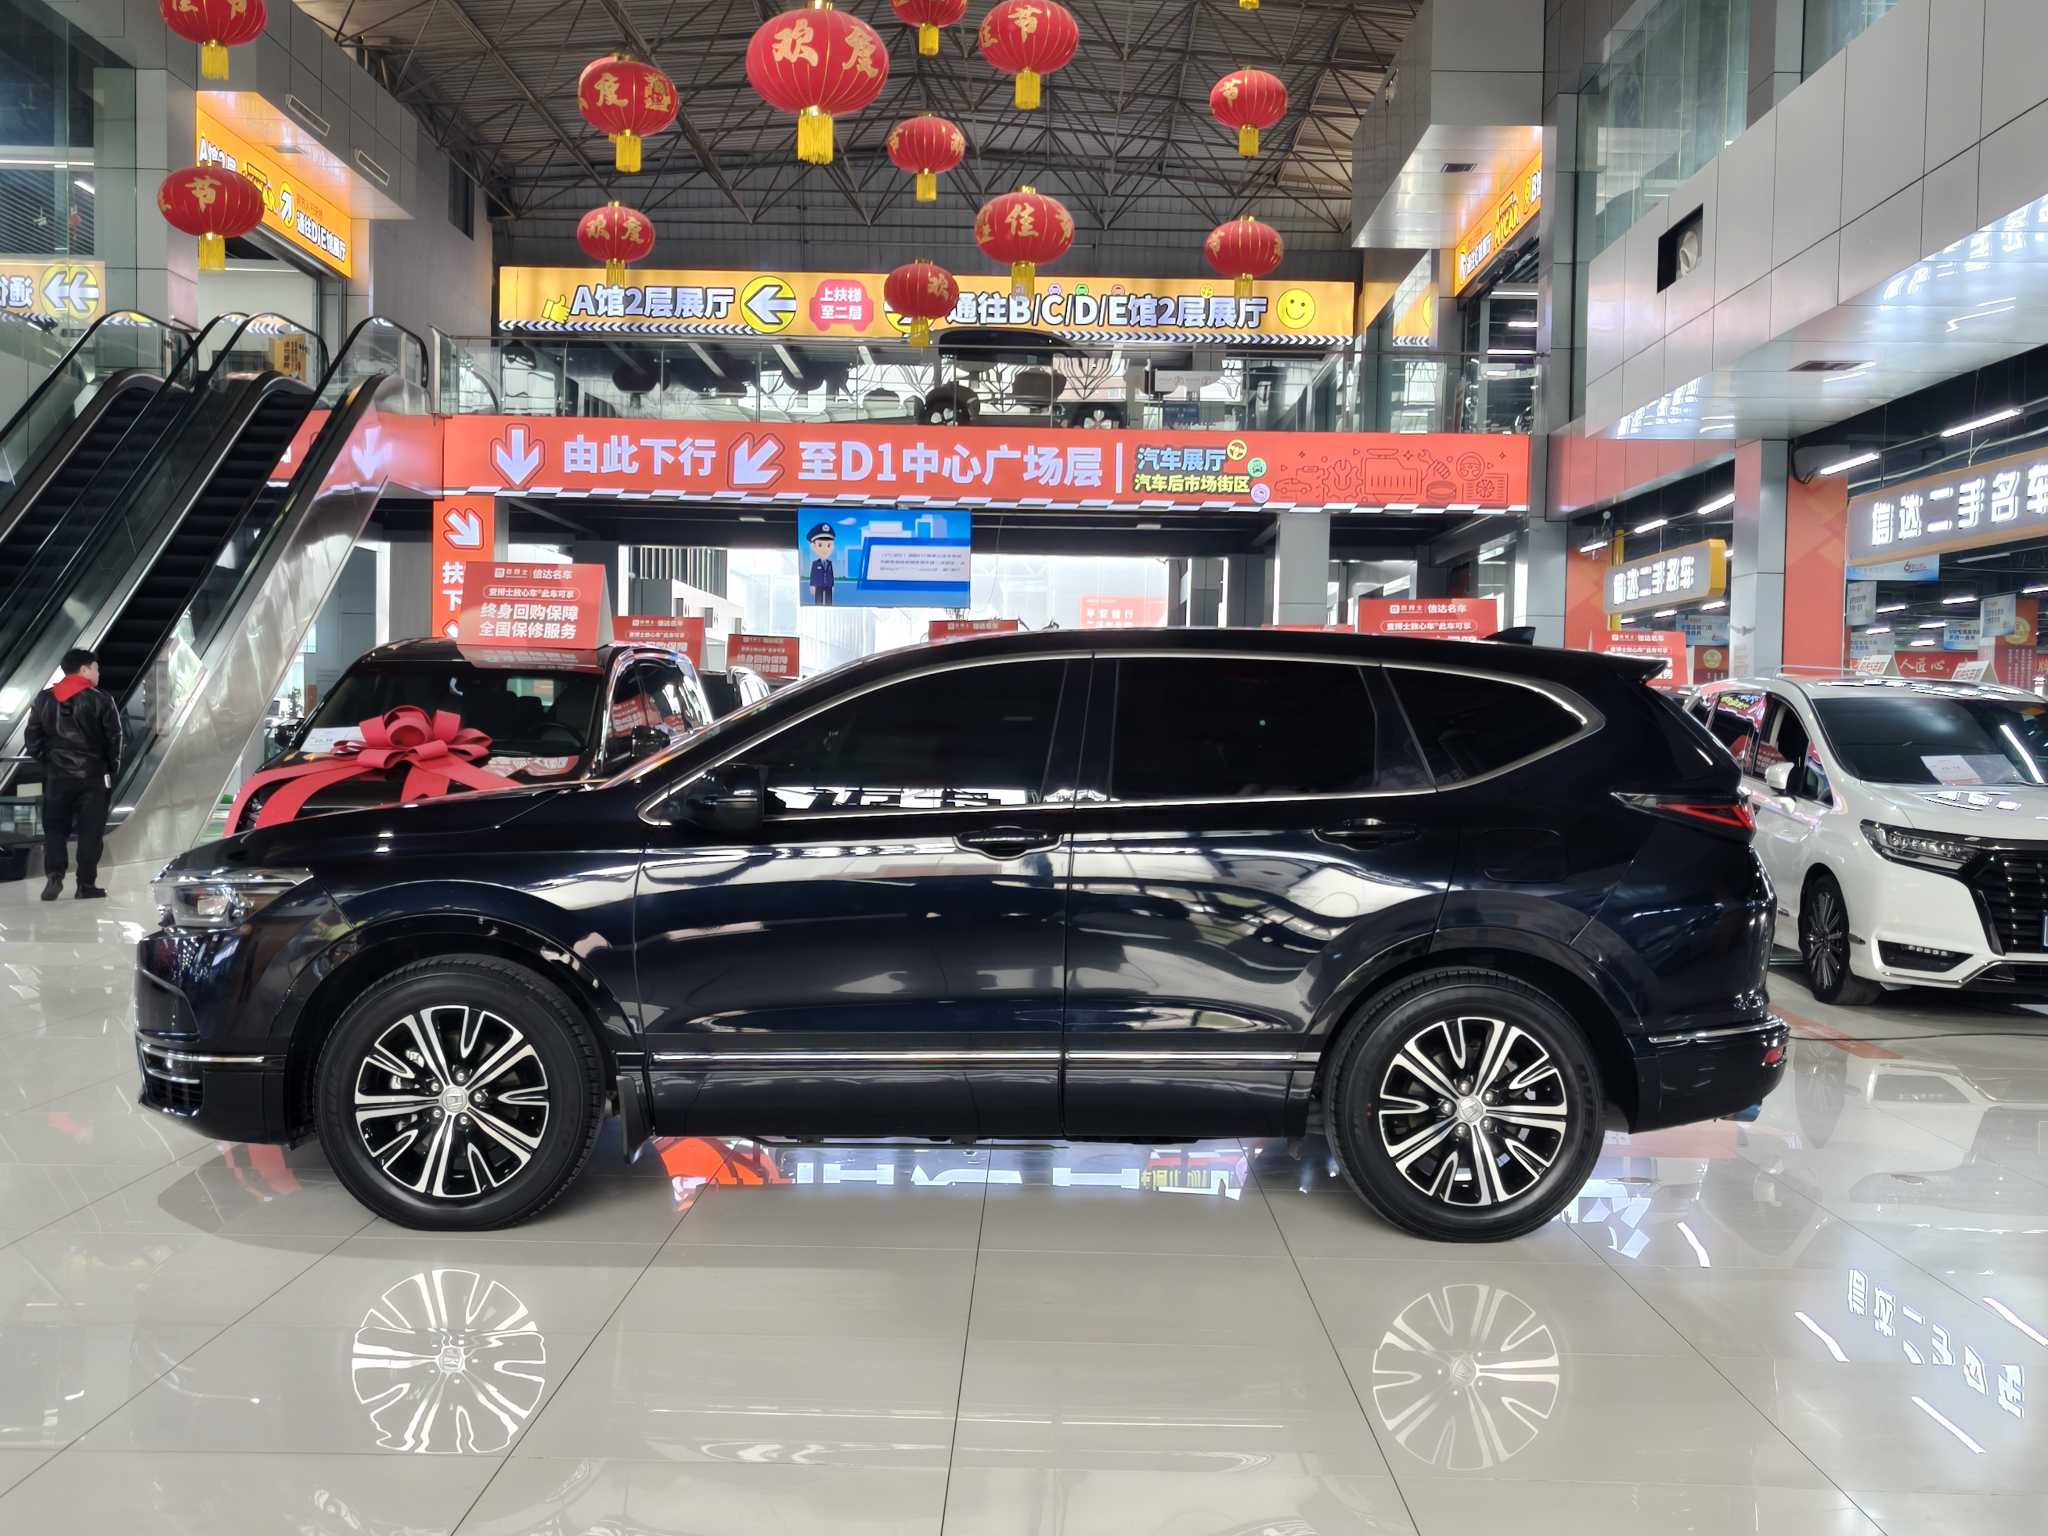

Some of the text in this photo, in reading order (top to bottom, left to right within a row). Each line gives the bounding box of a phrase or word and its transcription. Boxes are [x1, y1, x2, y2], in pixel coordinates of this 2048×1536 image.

[571, 284, 736, 319] A馆2层展厅
[819, 286, 862, 303] 上扶梯
[819, 303, 863, 321] 至二层
[946, 291, 1268, 329] 通往B/C/D/E馆2层展厅
[562, 434, 717, 478] 由此下行
[796, 439, 1104, 488] 至D1中心广场层
[1136, 447, 1227, 472] 汽车展厅
[1133, 473, 1251, 494] 汽车后市场街区
[1871, 463, 2048, 547] 信达二手名车
[479, 602, 579, 621] 终身回购保障
[479, 620, 577, 639] 全国保修服务
